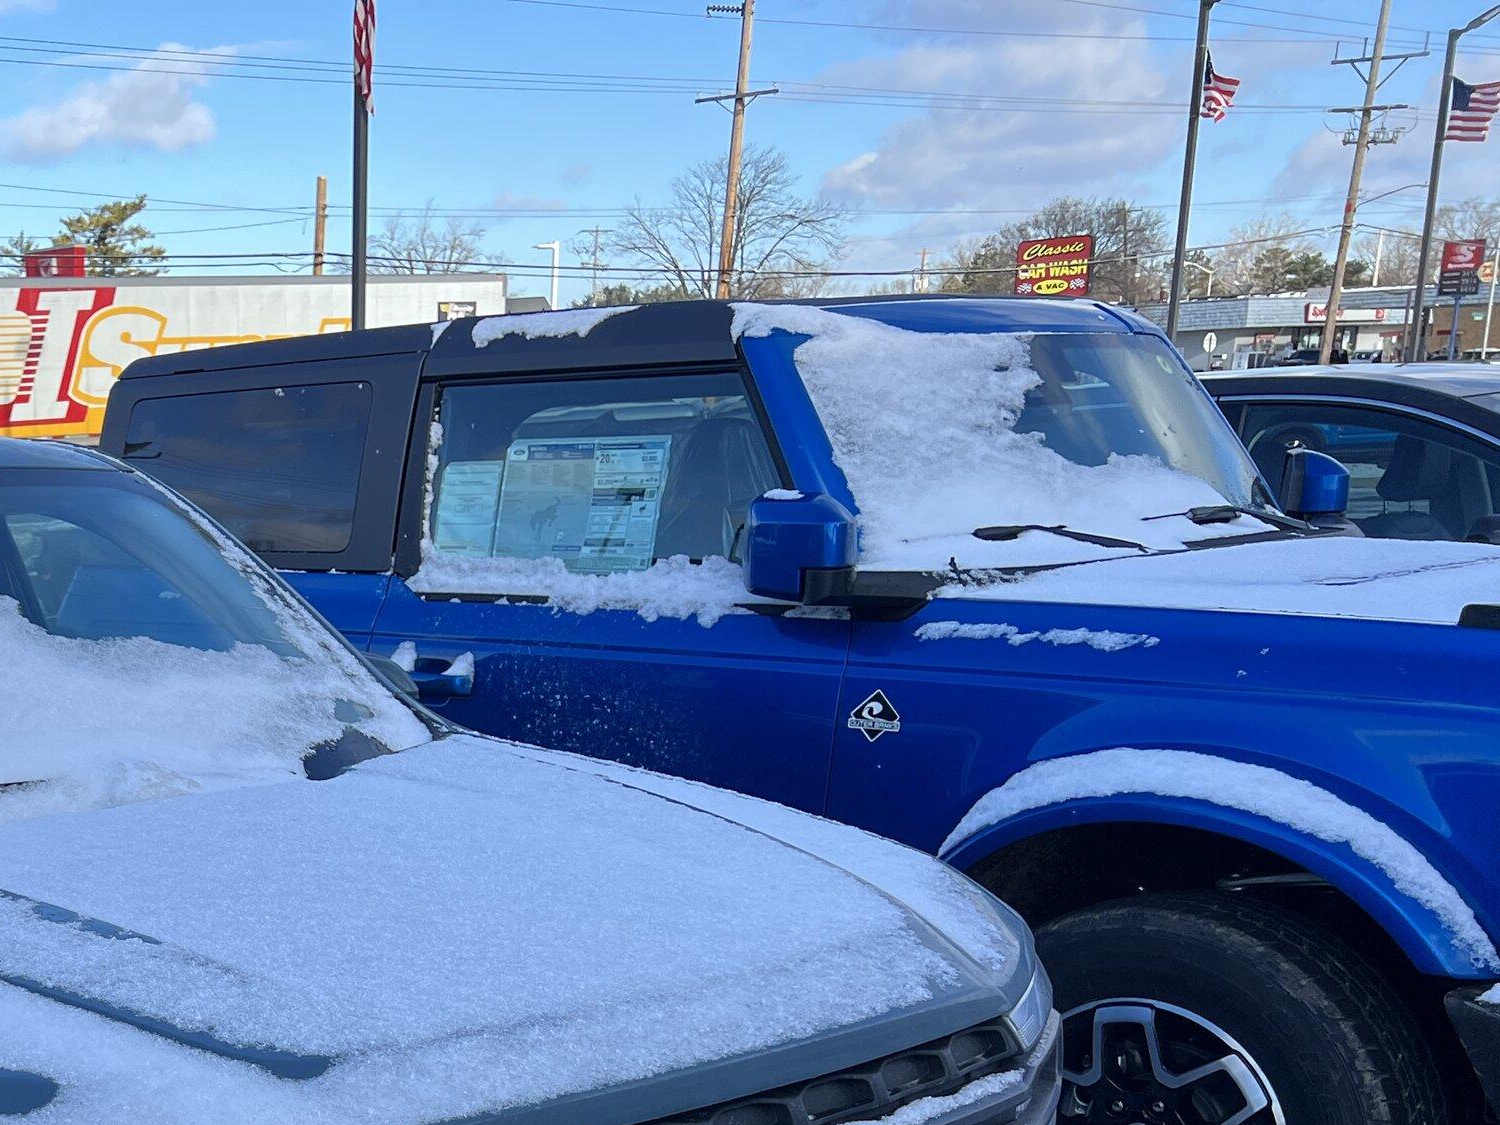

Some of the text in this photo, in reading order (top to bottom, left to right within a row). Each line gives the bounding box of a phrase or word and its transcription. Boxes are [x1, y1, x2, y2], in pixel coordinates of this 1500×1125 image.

[1022, 242, 1085, 260] Classic
[1018, 259, 1088, 280] CAR WASH
[1046, 282, 1065, 290] VAC
[874, 721, 898, 729] BANKS
